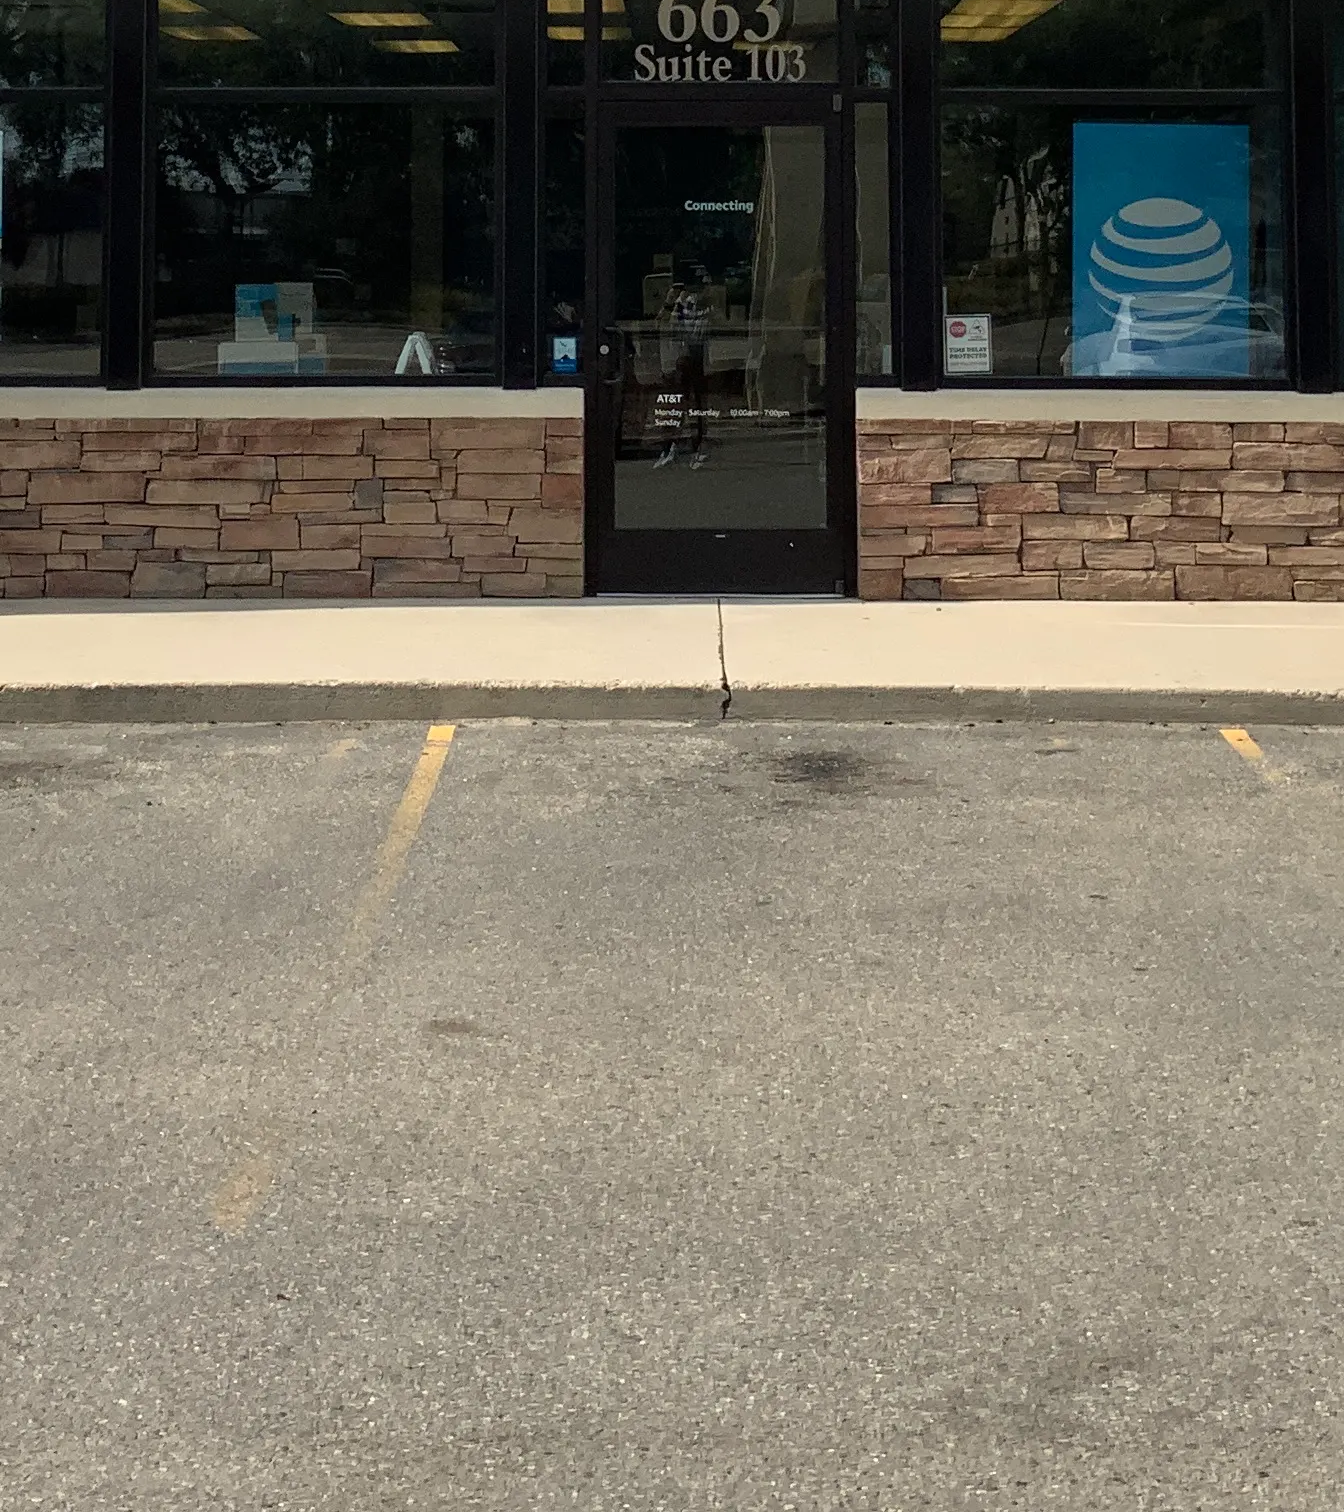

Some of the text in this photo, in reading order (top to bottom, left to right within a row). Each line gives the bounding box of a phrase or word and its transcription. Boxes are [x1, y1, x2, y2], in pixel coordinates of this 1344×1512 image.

[634, 43, 806, 83] Suite 103
[684, 199, 755, 214] Connecting
[656, 394, 683, 403] AT&T
[654, 408, 683, 417] Monday
[688, 408, 720, 418] Saturday
[654, 418, 682, 428] Sunday
